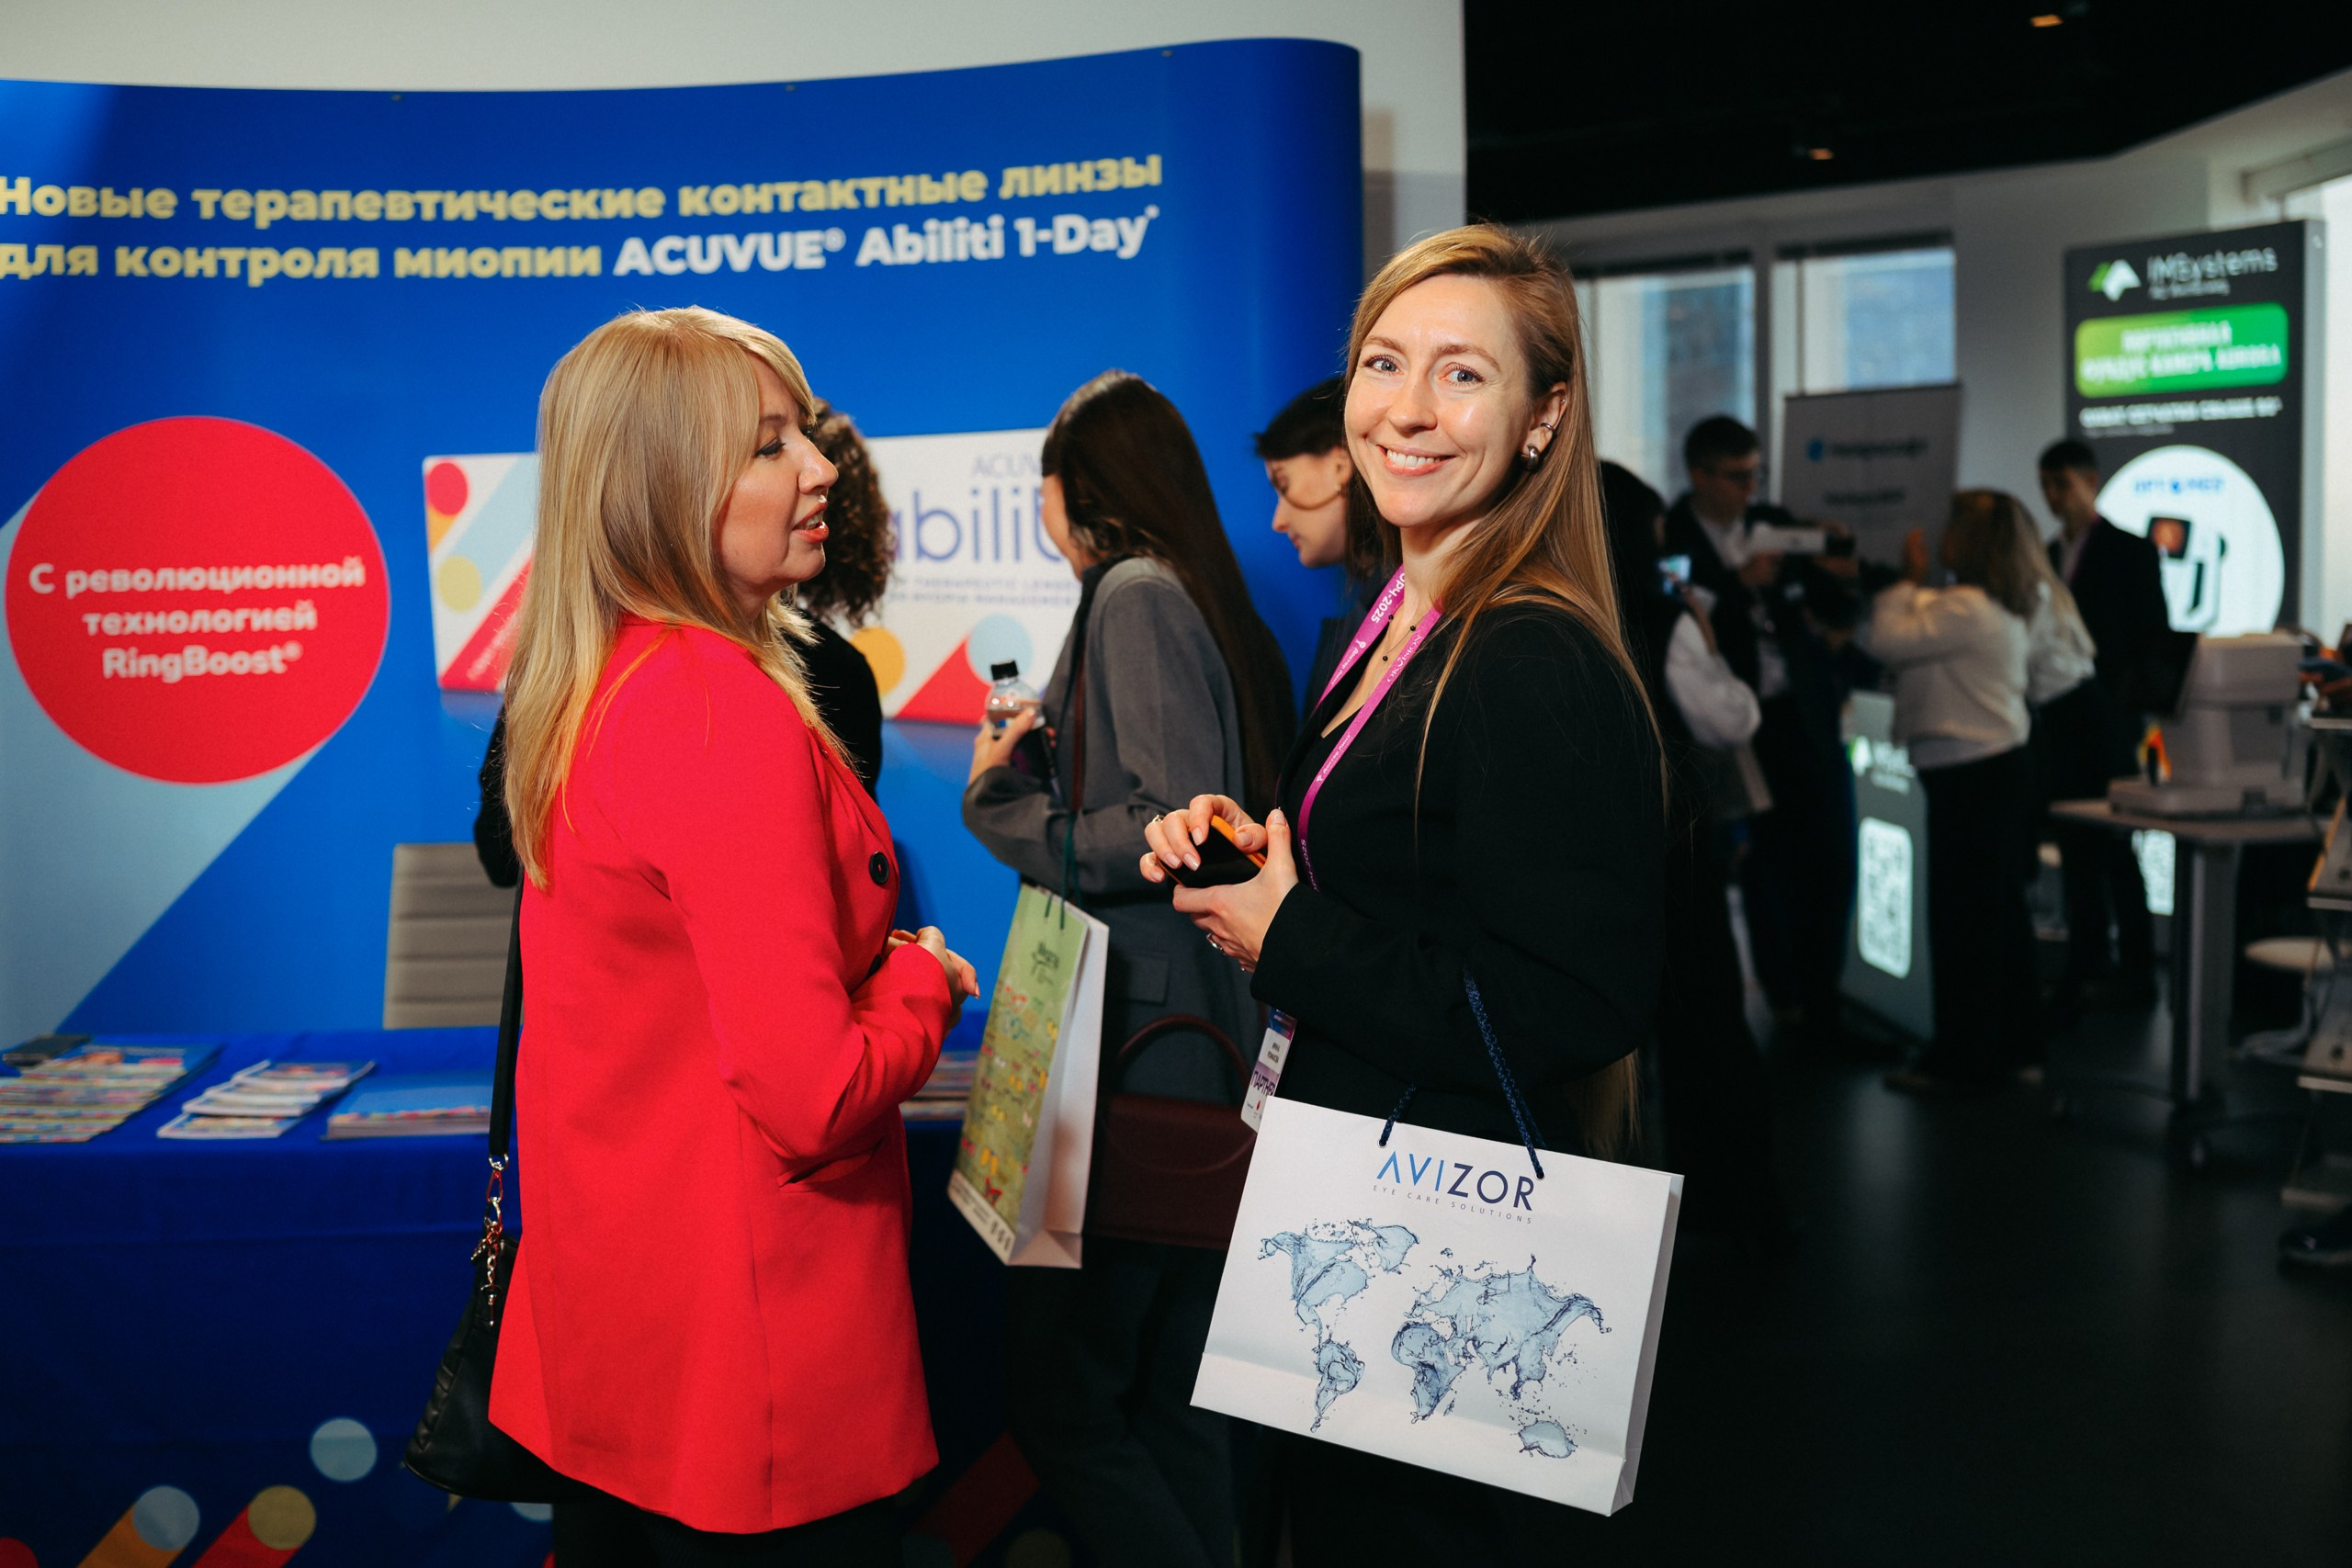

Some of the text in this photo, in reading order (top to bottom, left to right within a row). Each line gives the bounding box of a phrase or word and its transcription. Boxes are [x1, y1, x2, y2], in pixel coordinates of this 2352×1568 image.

[0, 155, 1161, 230] Новые терапевтические контактные линзы
[0, 243, 98, 280] для
[116, 246, 379, 288] контроля
[395, 245, 602, 278] миопии
[614, 227, 846, 276] ACUVUE®
[855, 214, 1005, 267] Abiliti
[971, 452, 1043, 479] ACUV
[889, 485, 1063, 563] bilit
[28, 556, 366, 599] С революционной
[83, 600, 318, 636] технологией
[1373, 1184, 1532, 1224] EYE CARE SOLUTIONS
[1375, 1150, 1535, 1212] AVIZOR
